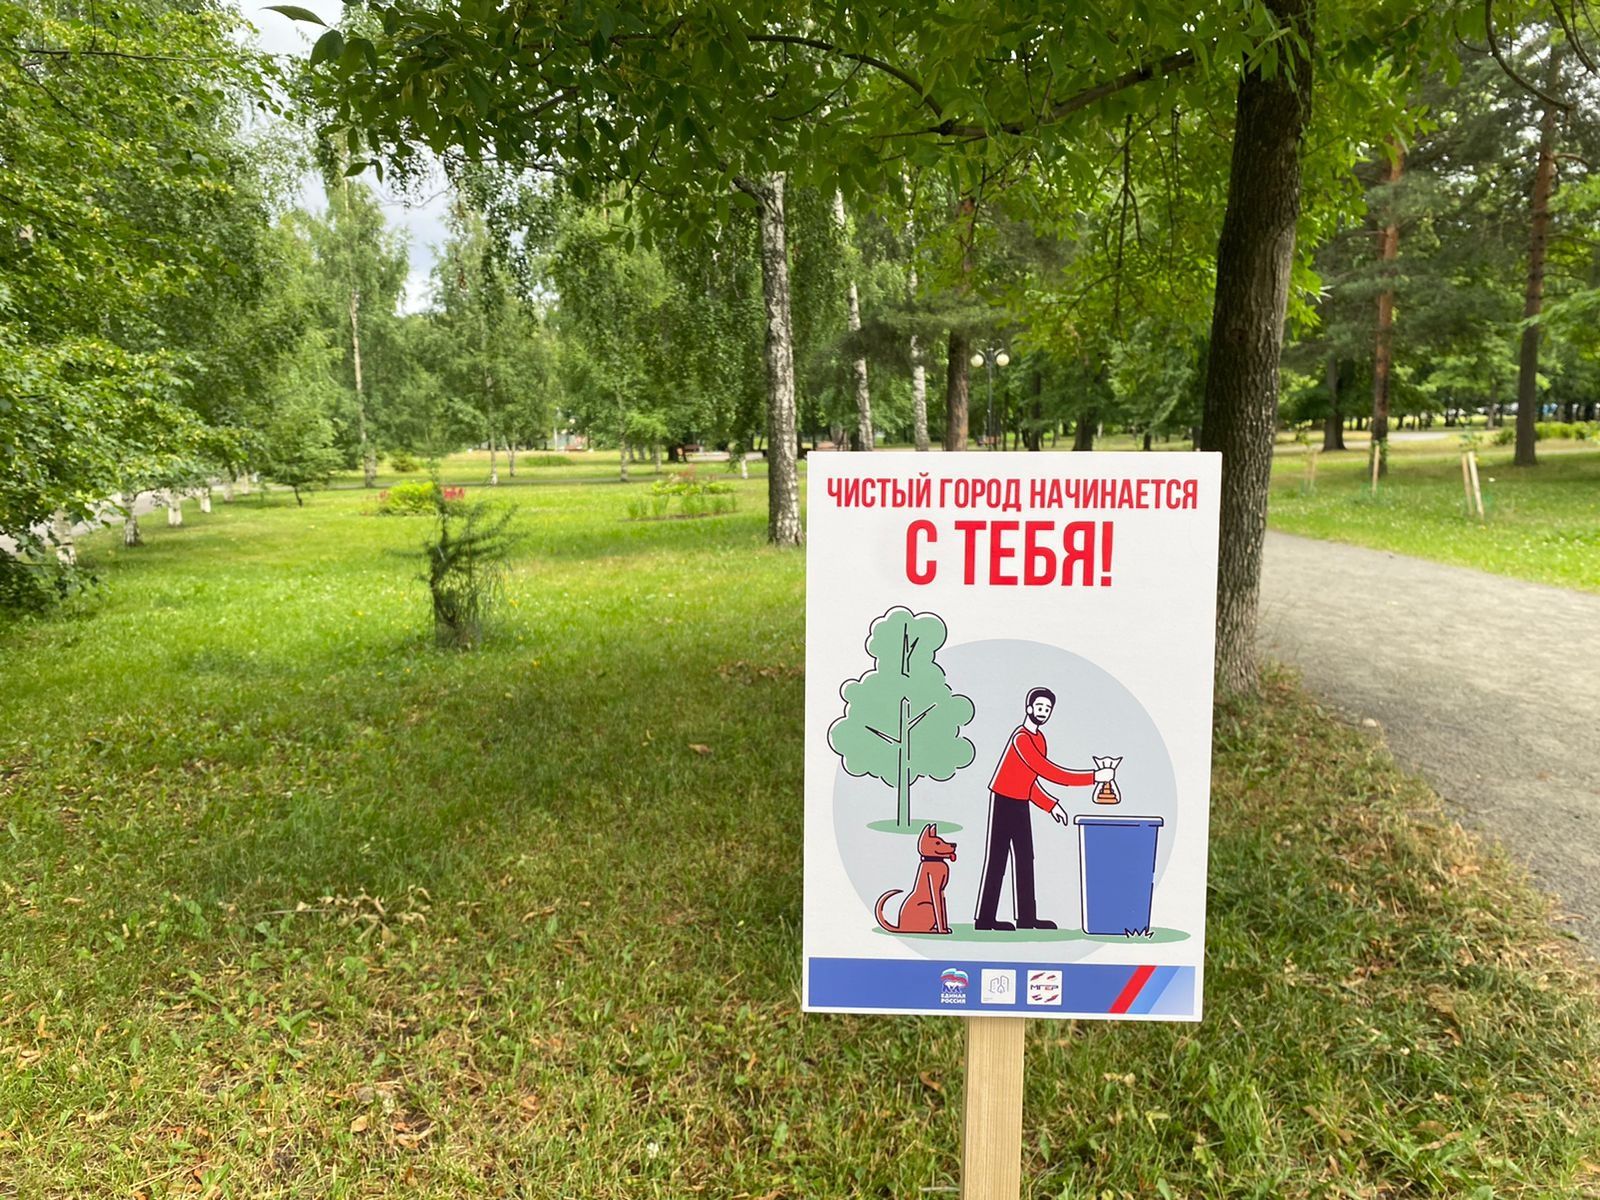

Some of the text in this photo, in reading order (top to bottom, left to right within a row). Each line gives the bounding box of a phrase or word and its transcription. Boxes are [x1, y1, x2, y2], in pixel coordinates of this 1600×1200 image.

[827, 472, 1198, 512] ЧИСТЫЙ ГОРОД НАЧИНАЕТСЯ
[905, 519, 1114, 587] С ТЕБЯ!
